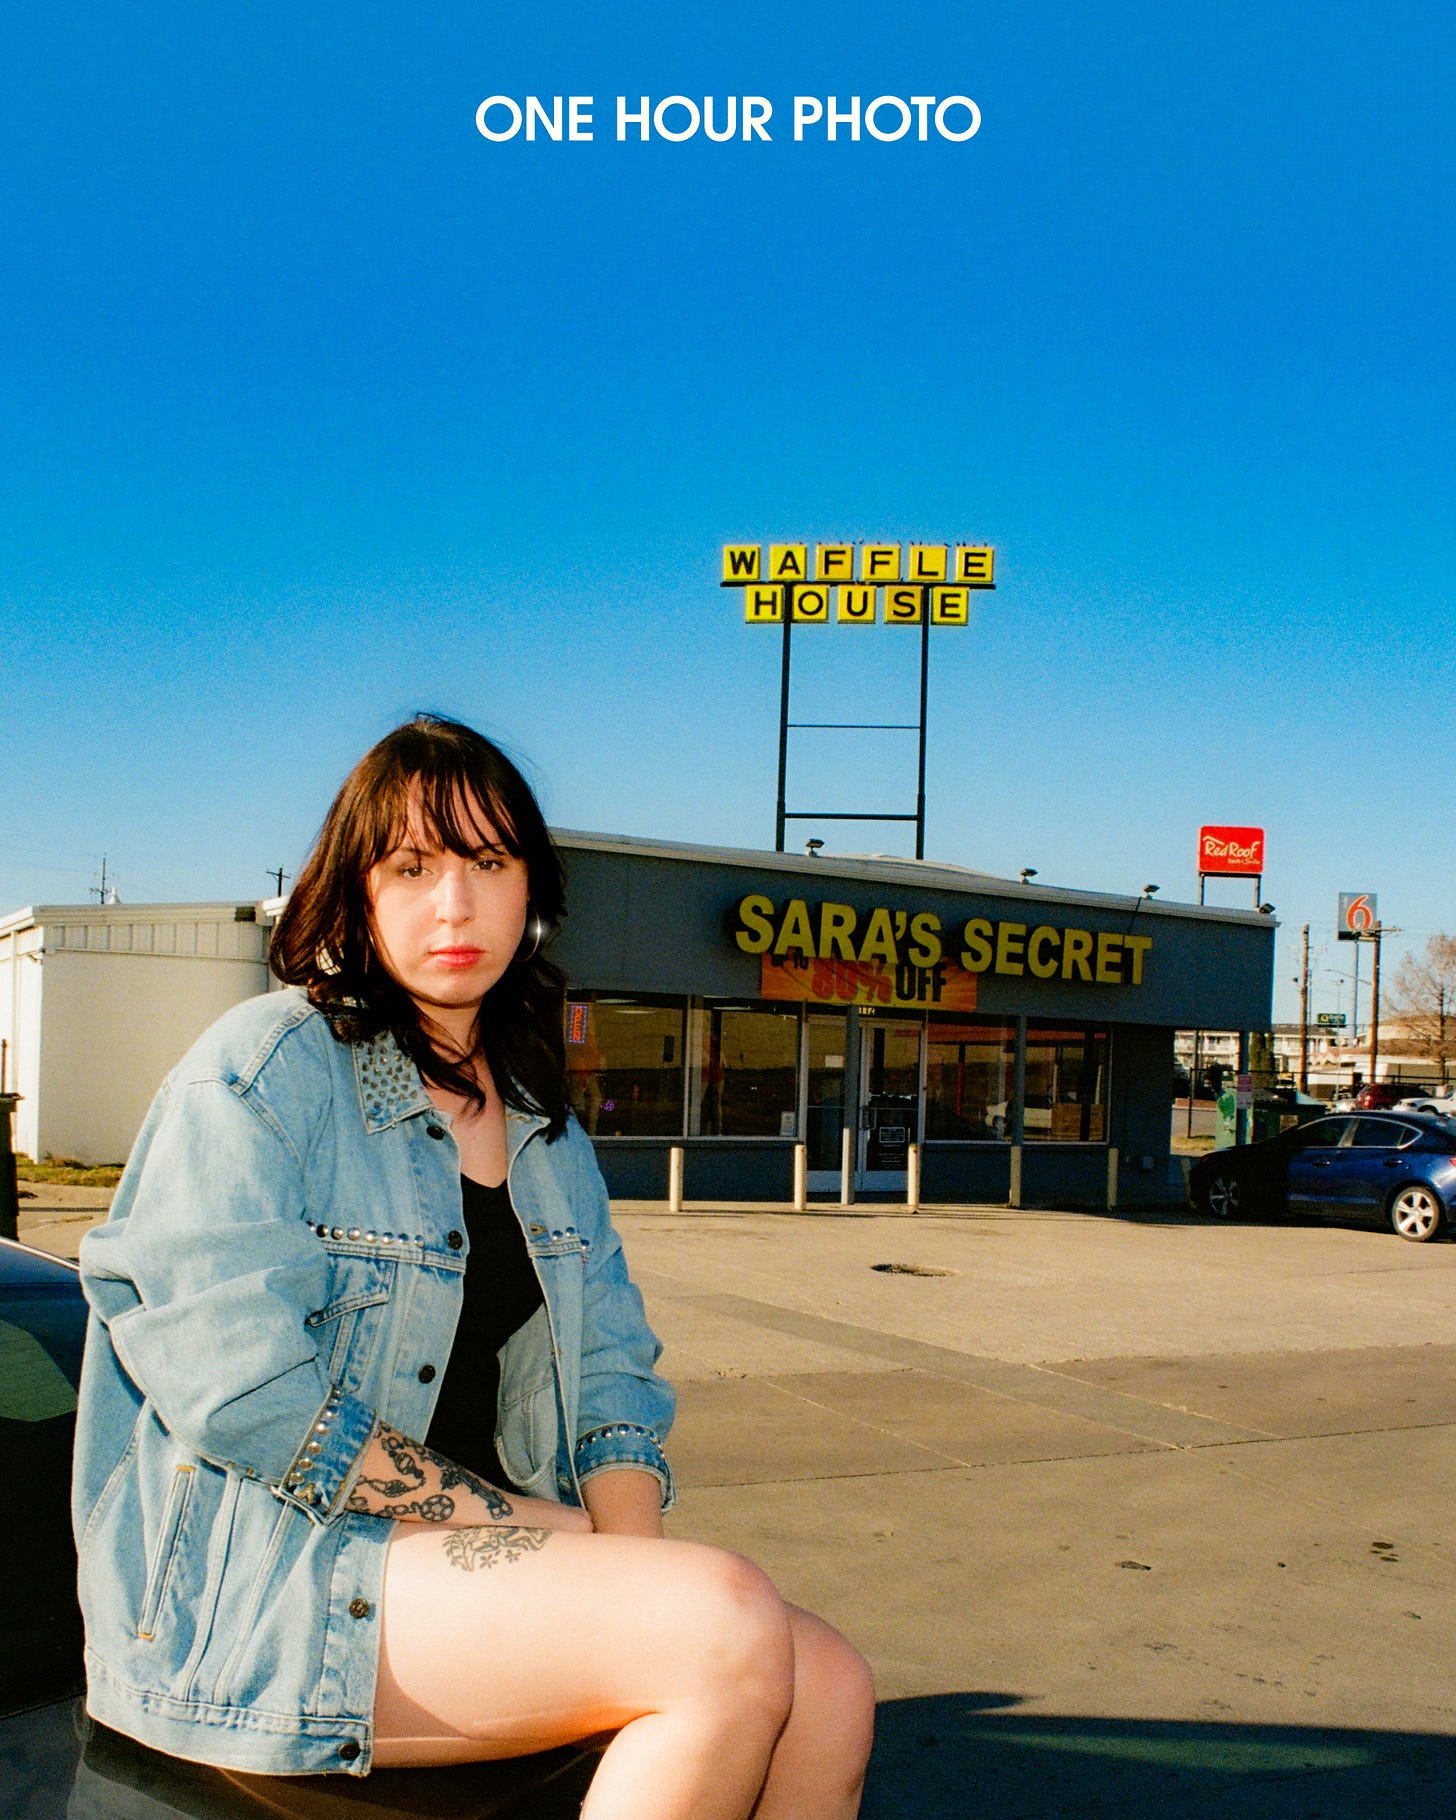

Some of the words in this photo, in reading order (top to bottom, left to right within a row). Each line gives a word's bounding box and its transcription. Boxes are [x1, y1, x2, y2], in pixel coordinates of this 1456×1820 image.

[729, 549, 987, 578] WAFFLE
[754, 590, 961, 618] HOUSE
[1205, 841, 1229, 856] Red
[1229, 841, 1261, 858] Roof
[1346, 894, 1373, 931] 6
[735, 894, 942, 969] SARA'S
[961, 917, 1153, 985] SECRET
[896, 962, 947, 1001] OFF
